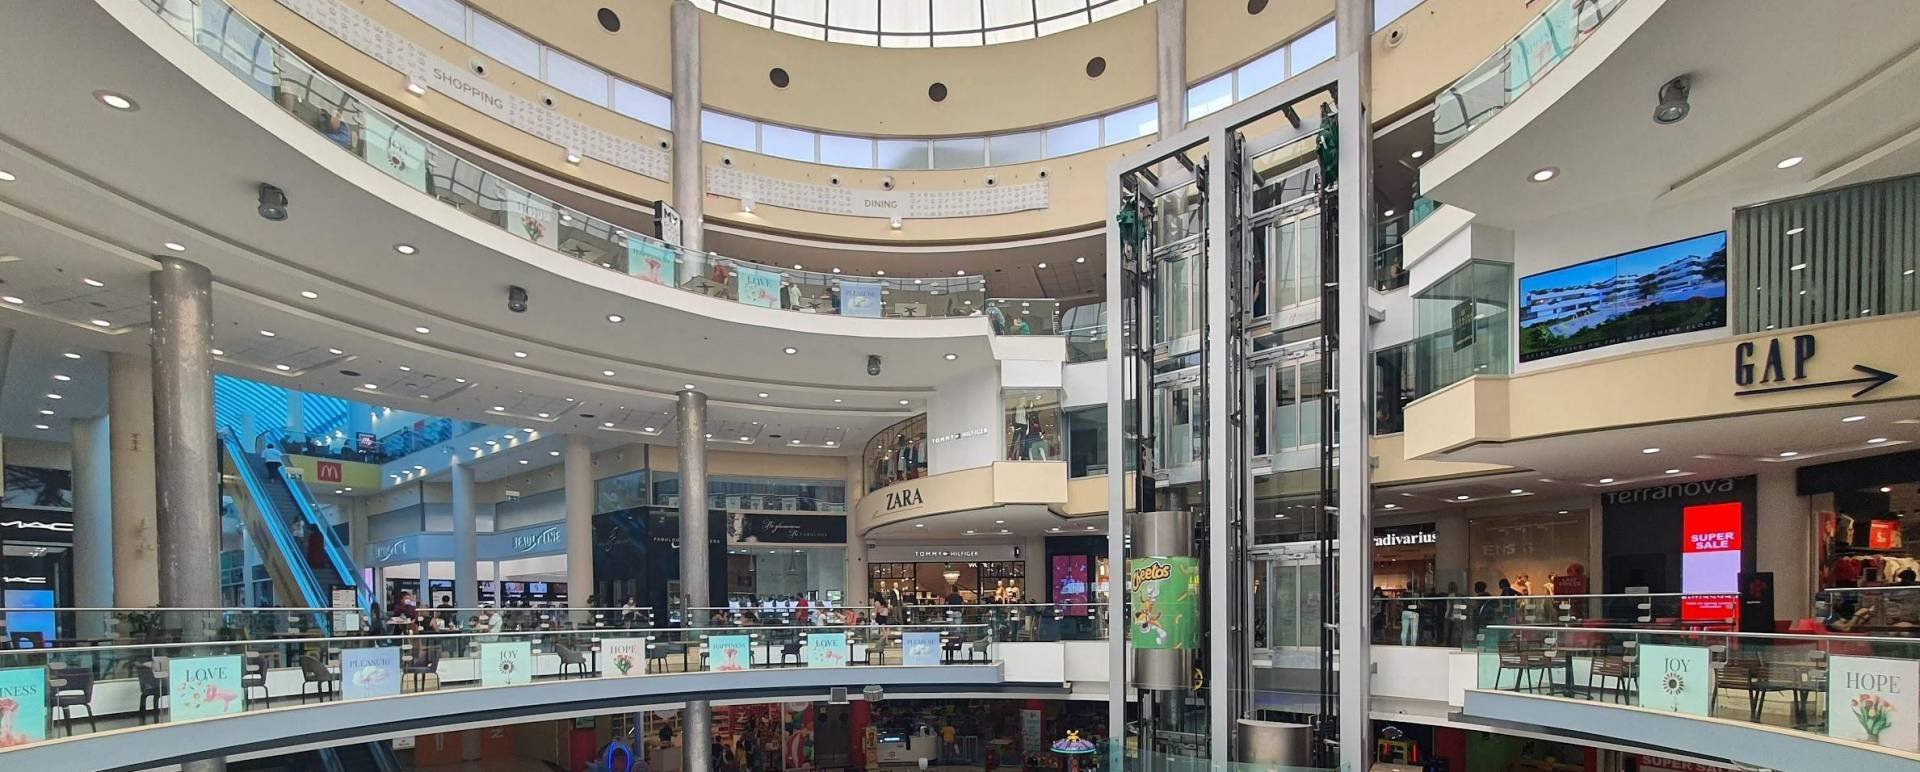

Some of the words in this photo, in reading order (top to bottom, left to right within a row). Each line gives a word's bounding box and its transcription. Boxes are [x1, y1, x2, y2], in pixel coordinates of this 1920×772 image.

[433, 68, 504, 109] SHOPPING
[864, 199, 898, 208] DINING
[1735, 334, 1816, 386] GAP
[932, 434, 955, 444] TOMMY
[886, 487, 924, 511] ZARA
[1691, 532, 1735, 543] SUPER
[1695, 540, 1729, 550] SALE
[1131, 562, 1172, 592] Cheetos
[610, 643, 637, 654] HOPE
[815, 639, 838, 648] LOVE
[500, 648, 519, 660] JOY
[1664, 657, 1691, 673] JOY
[186, 666, 228, 682] LOVE
[1846, 671, 1901, 694] HOPE
[1641, 754, 1693, 772] SUPER
